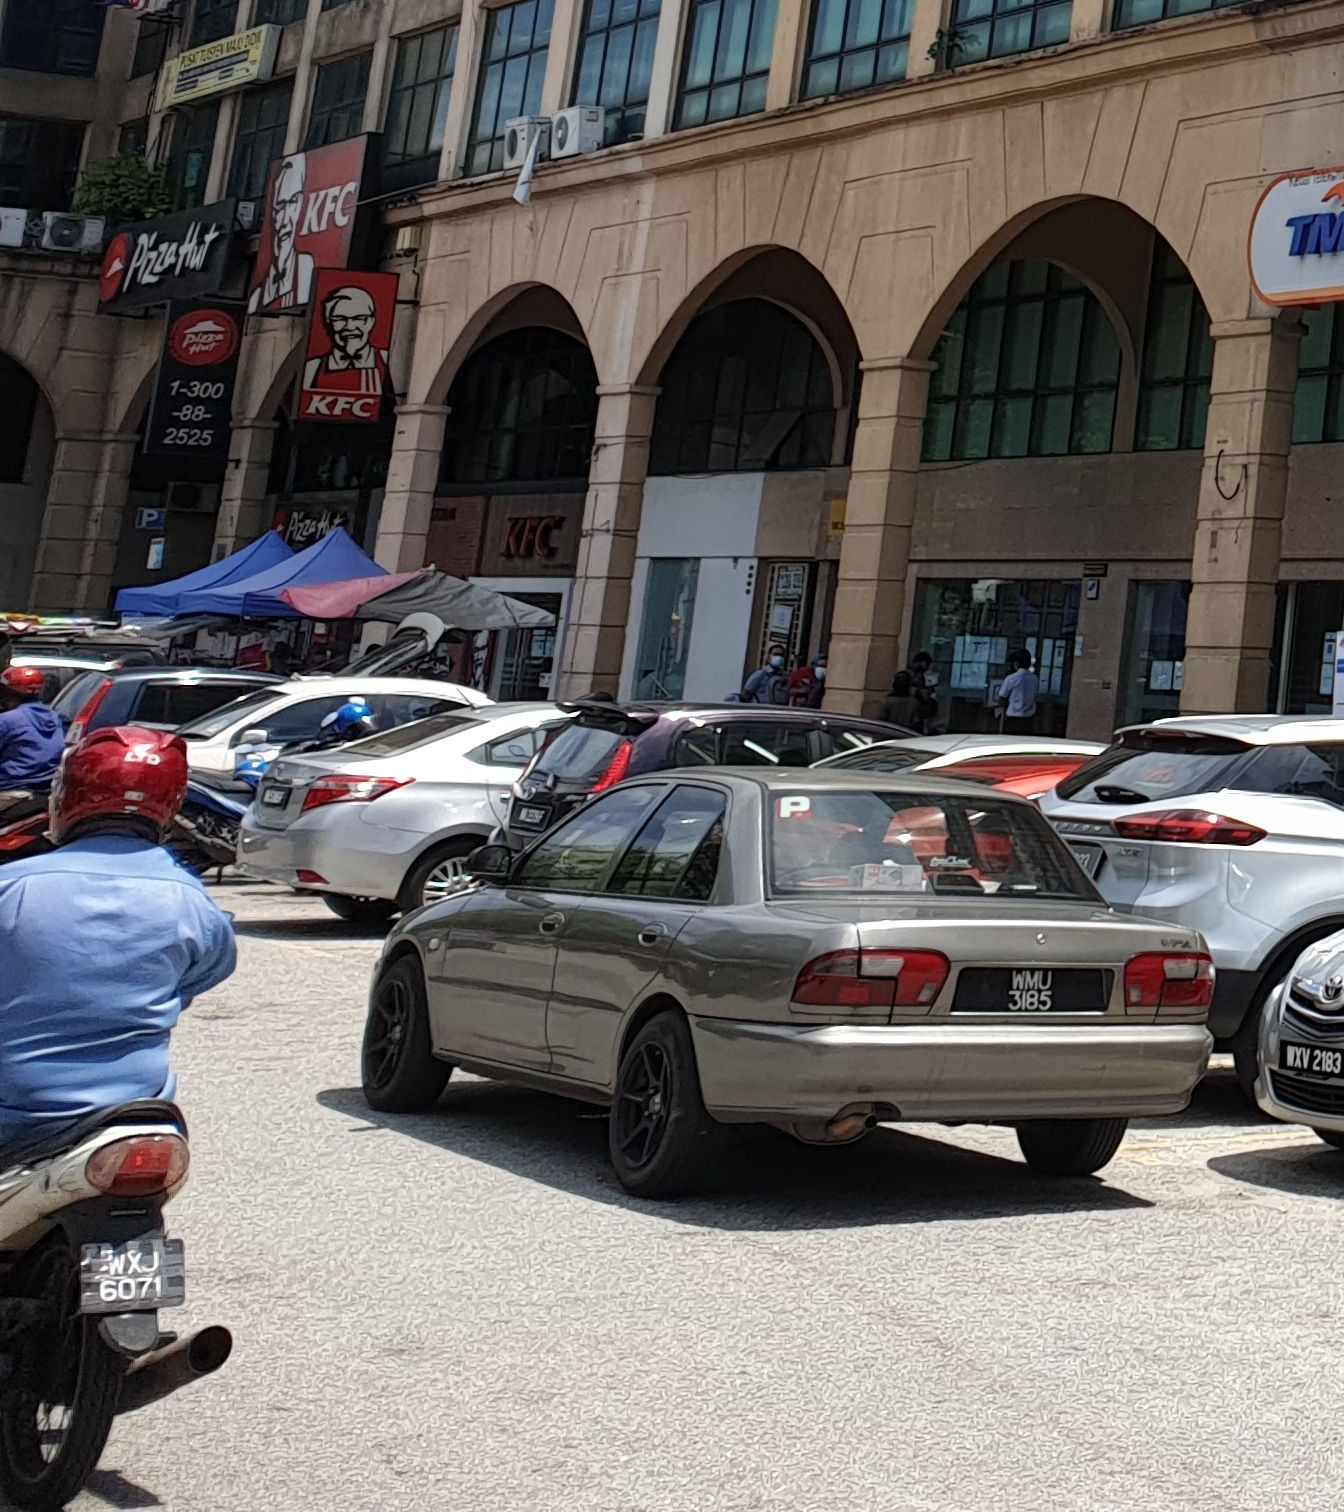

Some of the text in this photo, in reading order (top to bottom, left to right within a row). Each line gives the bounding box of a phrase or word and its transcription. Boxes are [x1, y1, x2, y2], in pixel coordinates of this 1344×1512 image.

[300, 181, 357, 236] KFC
[122, 221, 220, 293] Pizza Hut
[169, 380, 224, 399] 1-300
[305, 394, 376, 418] KFC
[163, 428, 214, 446] 2525
[503, 516, 560, 558] KFC
[1012, 970, 1052, 990] WMU
[1008, 990, 1052, 1010] 3185
[1286, 1045, 1342, 1075] WXV 2183
[109, 1249, 159, 1276] WXJ
[99, 1277, 162, 1302] 6071
